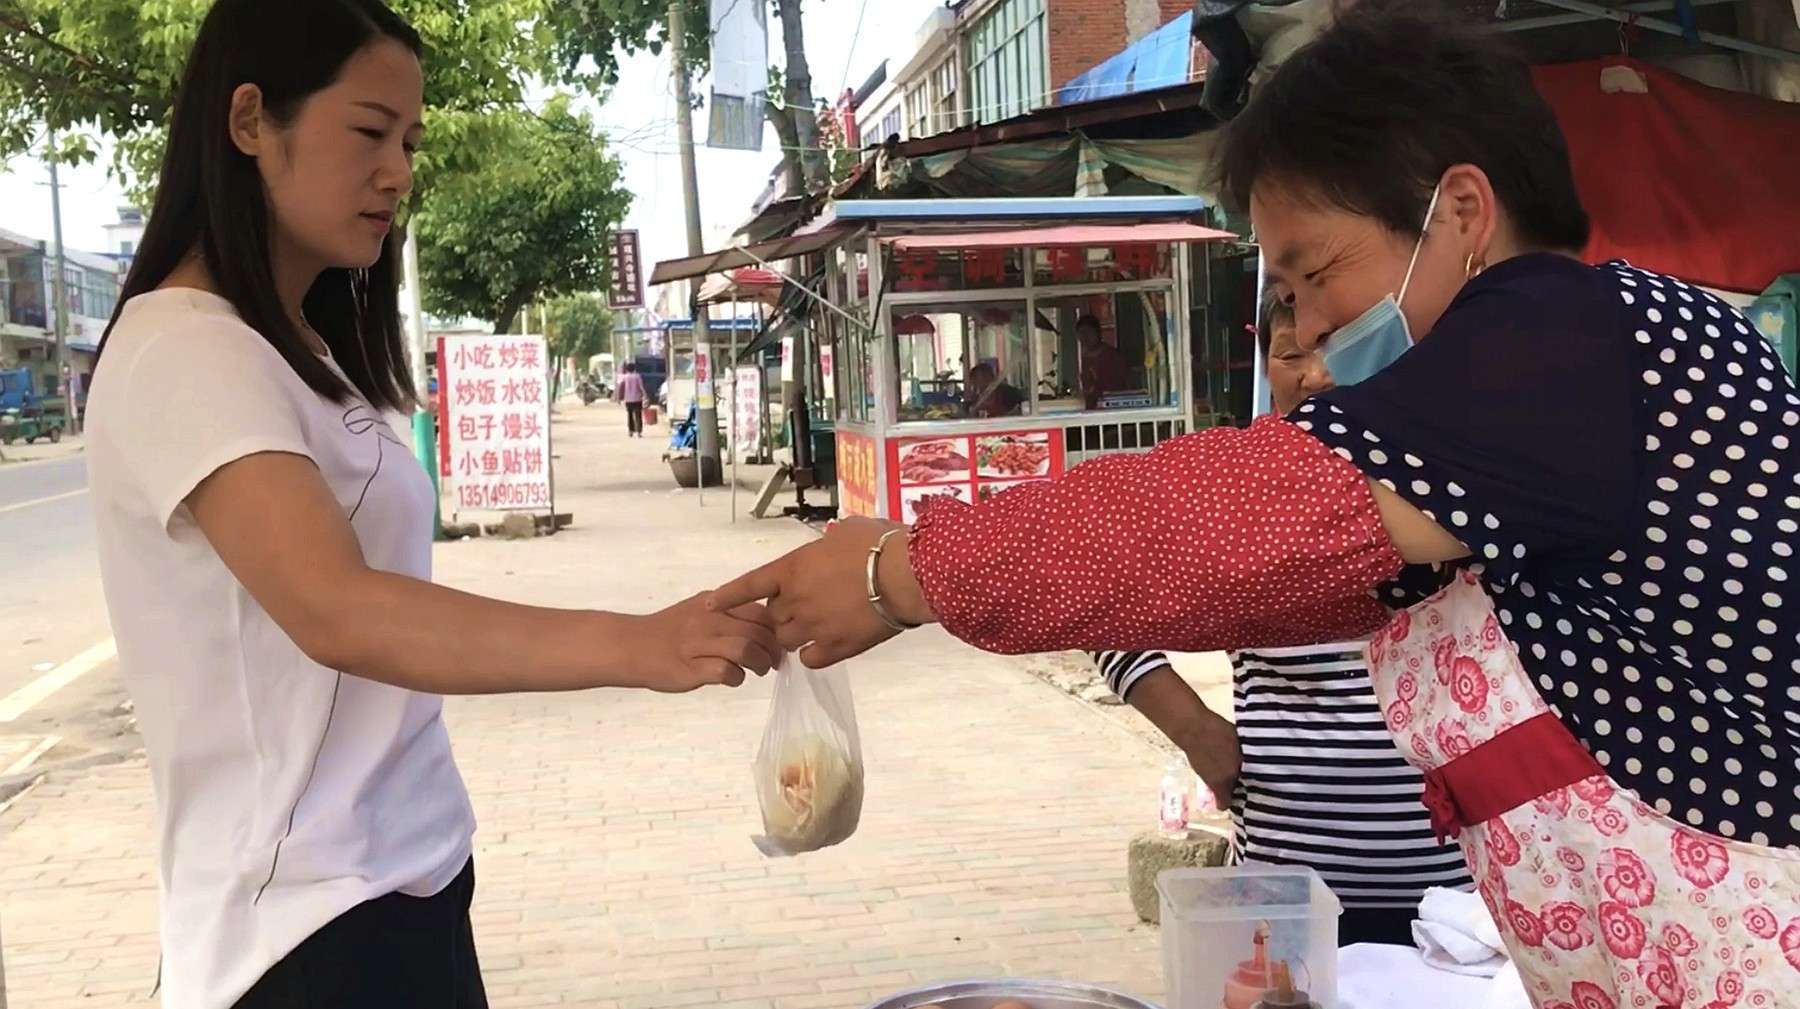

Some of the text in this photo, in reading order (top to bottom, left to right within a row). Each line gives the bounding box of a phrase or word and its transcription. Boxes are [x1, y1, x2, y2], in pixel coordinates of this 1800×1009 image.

[453, 342, 540, 369] 小吃 炒菜
[455, 378, 541, 405] 炒饭 水饺
[458, 414, 542, 441] 包子 馒头
[459, 448, 543, 476] 小鱼贴饼
